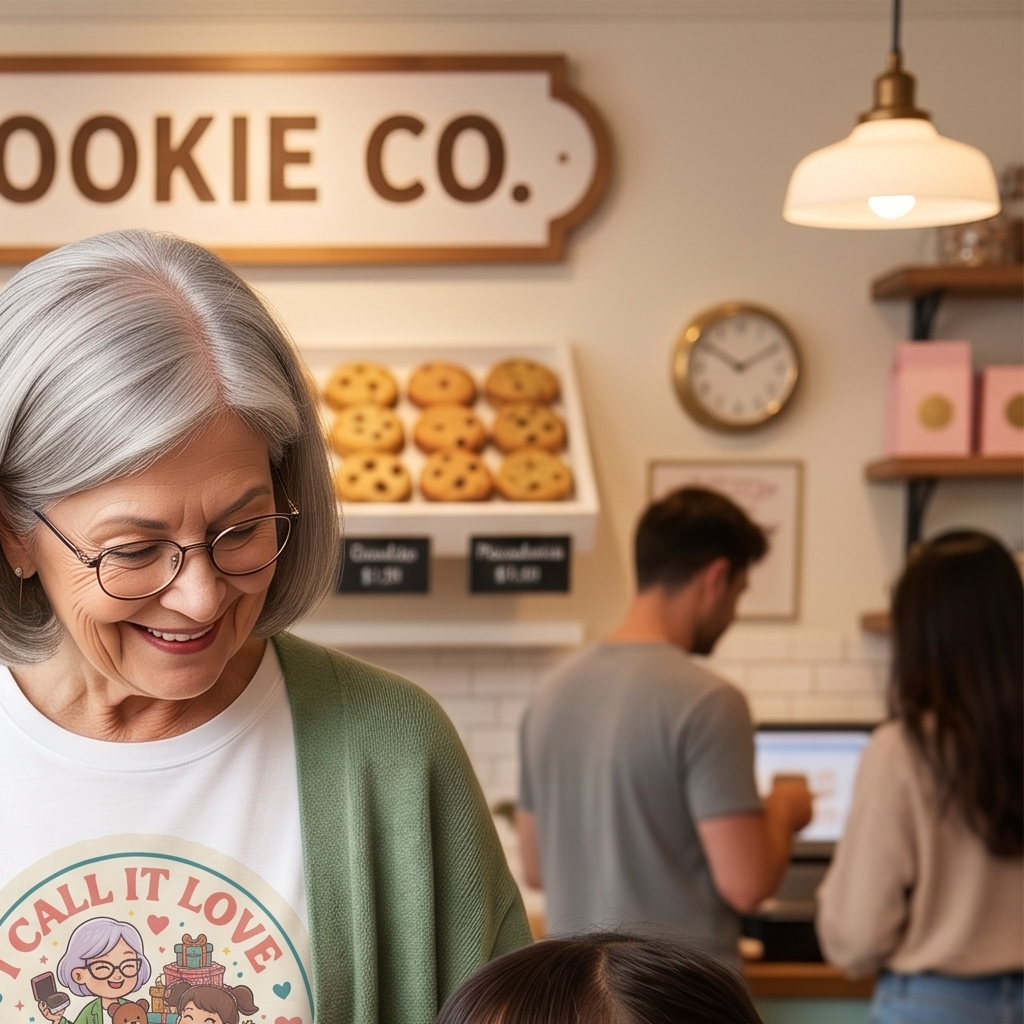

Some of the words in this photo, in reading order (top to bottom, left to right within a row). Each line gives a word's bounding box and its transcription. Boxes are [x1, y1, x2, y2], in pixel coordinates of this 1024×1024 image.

[364, 113, 533, 205] CO.
[7, 873, 114, 953] CALL
[124, 867, 170, 901] IT
[177, 876, 283, 974] LOVE
